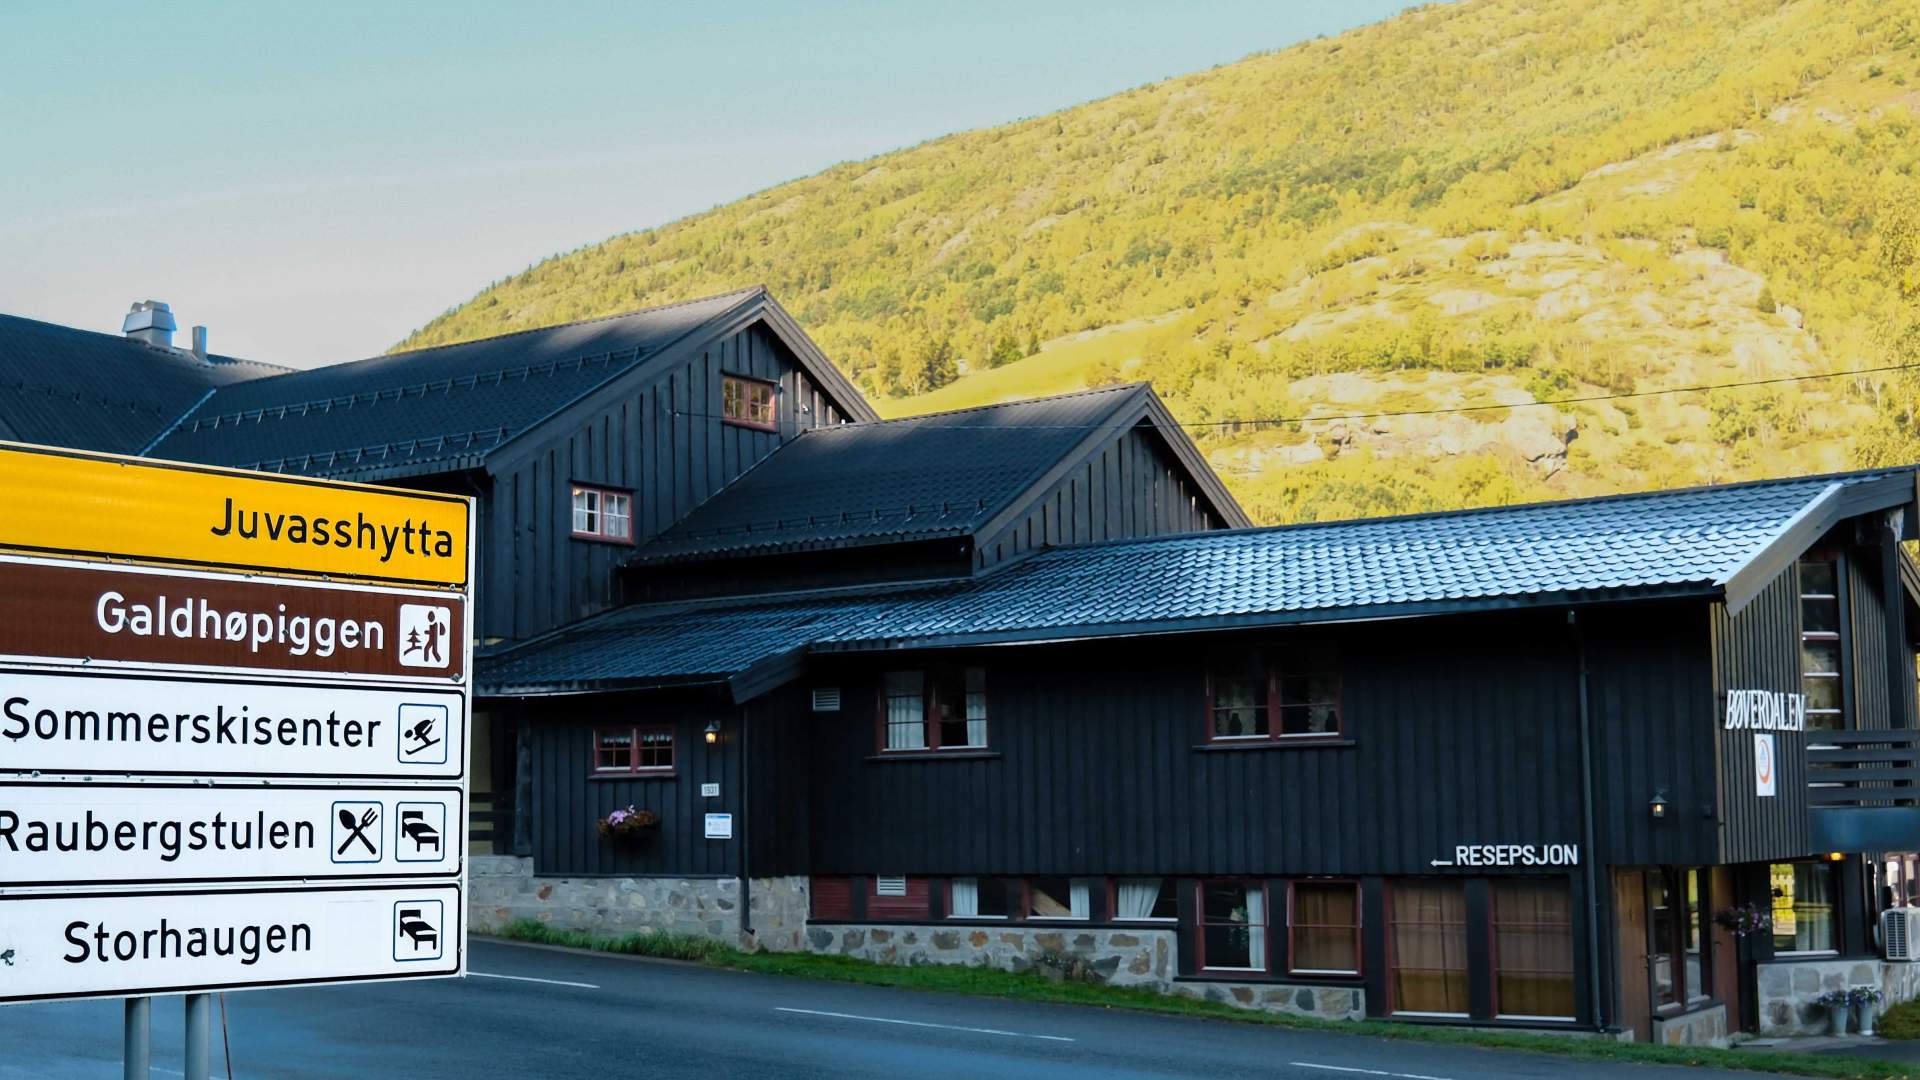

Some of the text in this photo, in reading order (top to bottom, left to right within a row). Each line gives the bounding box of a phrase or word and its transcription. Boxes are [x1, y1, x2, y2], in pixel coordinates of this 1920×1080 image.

[210, 498, 454, 563] Juvasshytta
[97, 591, 385, 657] Galdhøpiggen
[2, 697, 381, 748] Sommerskisenter
[1725, 689, 1805, 731] BØVERDALEN
[0, 810, 315, 862] Raubergstulen
[1455, 844, 1578, 866] RESEPSJON
[63, 918, 312, 965] Storhaugen
